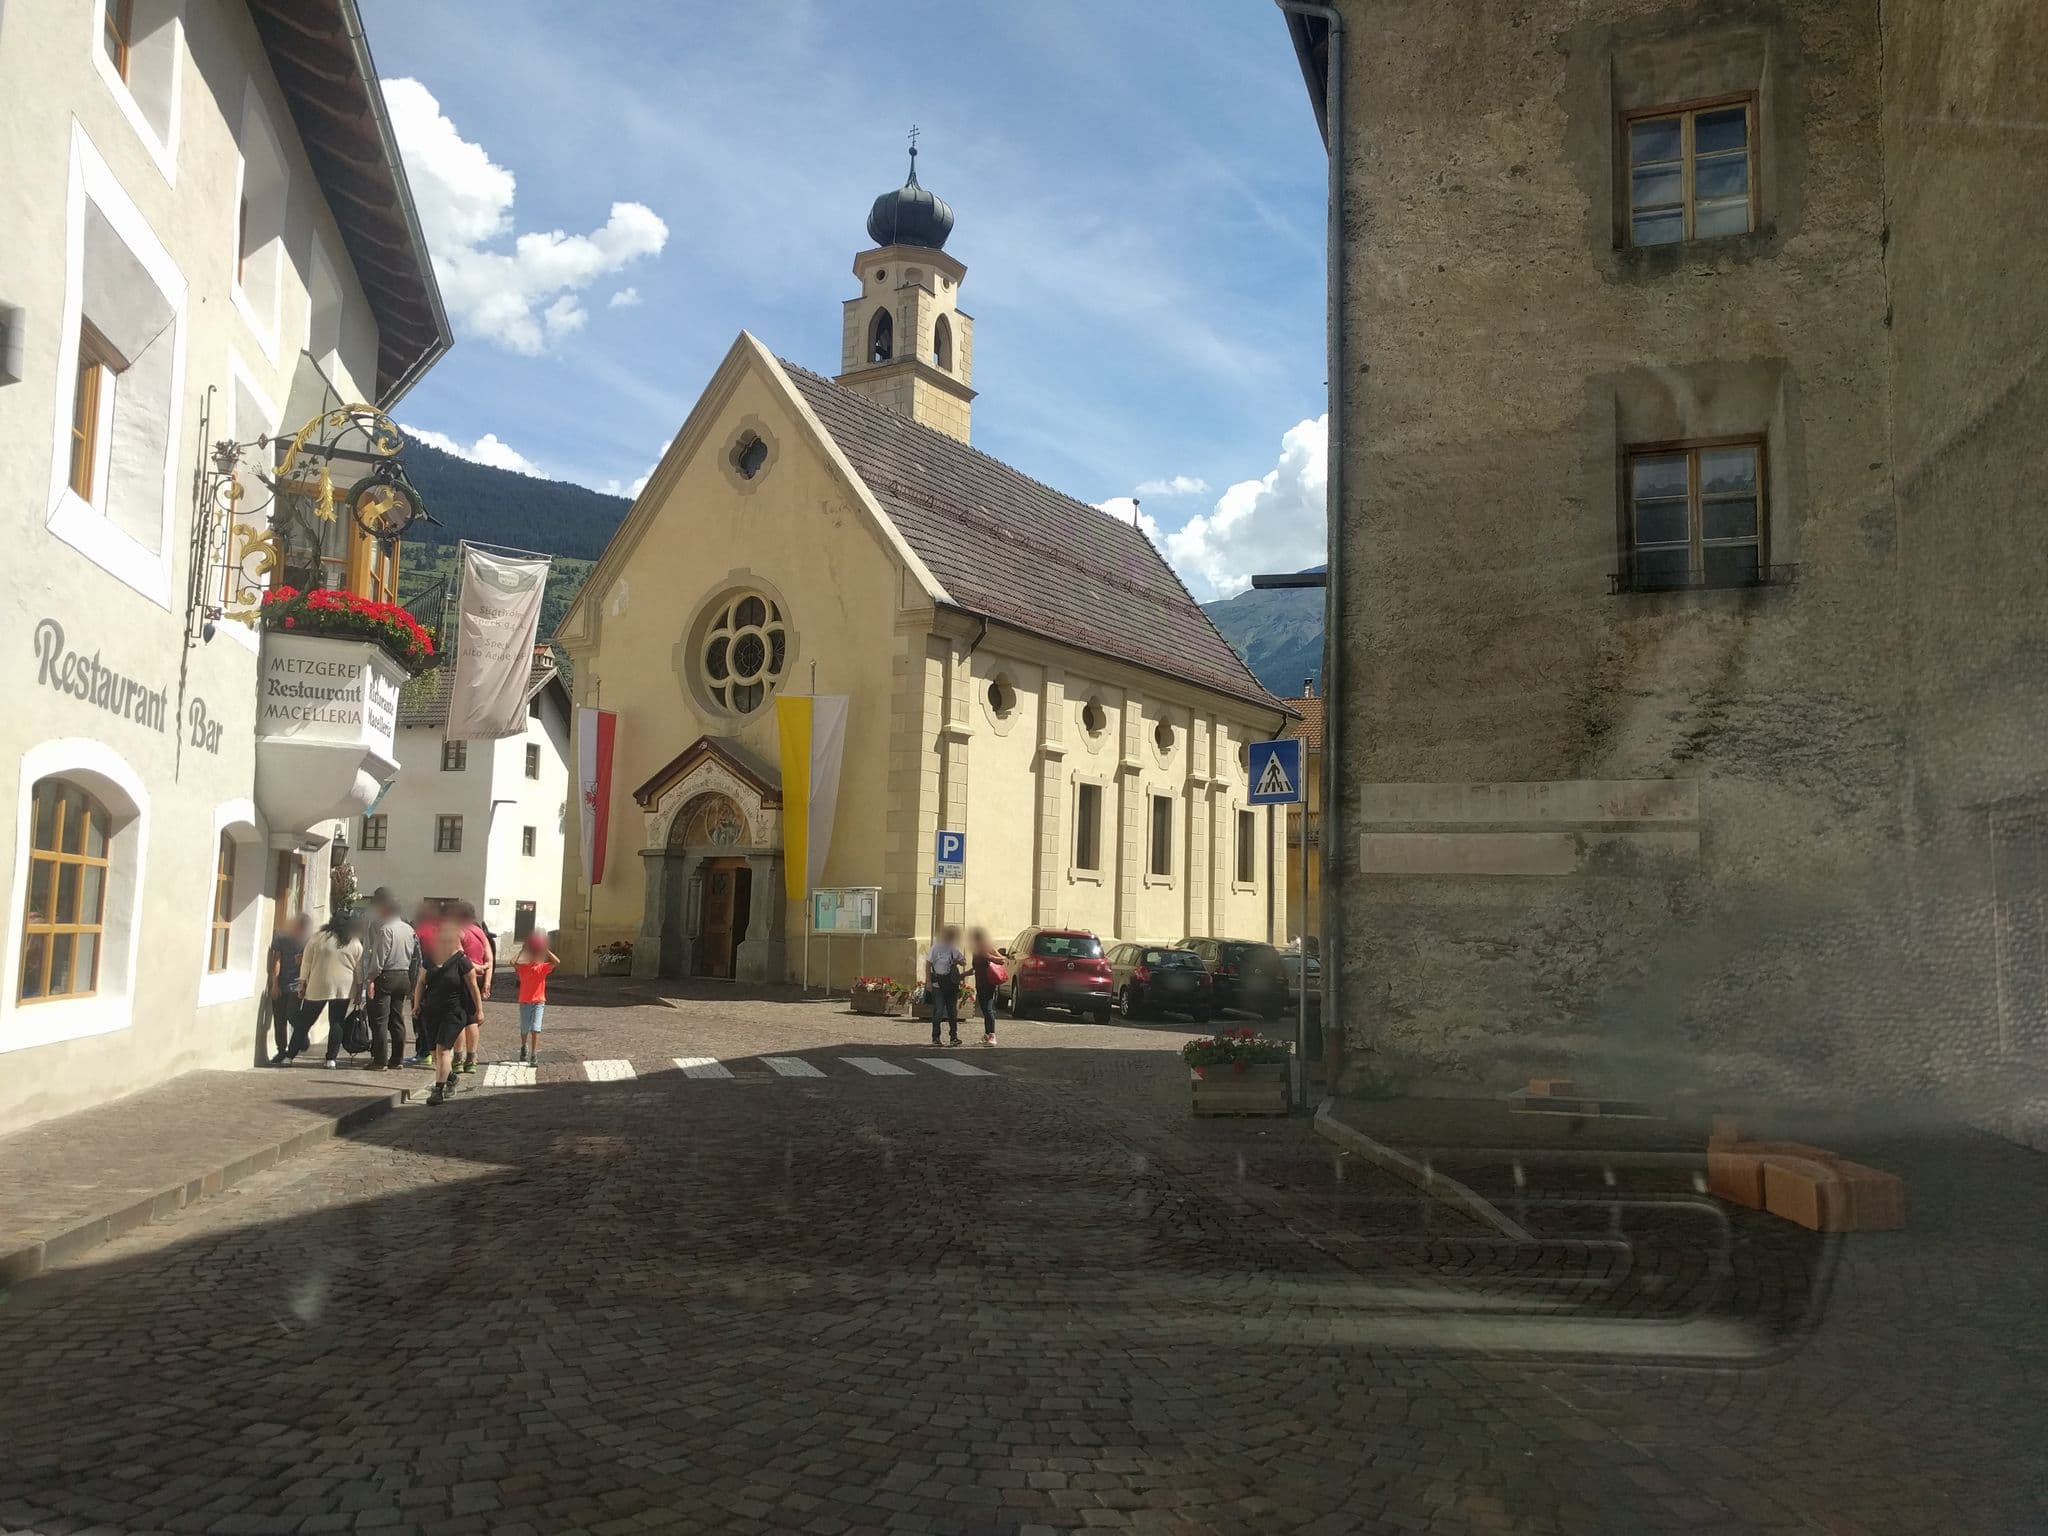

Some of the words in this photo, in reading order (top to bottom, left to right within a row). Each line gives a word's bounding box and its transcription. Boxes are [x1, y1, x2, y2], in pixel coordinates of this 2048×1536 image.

[462, 648, 482, 657] Alto
[33, 618, 168, 733] Restaurant
[270, 657, 361, 679] METZGEREI
[267, 678, 362, 702] Restaurant
[189, 697, 223, 755] Bar
[263, 703, 362, 725] MACELLERIA
[367, 706, 392, 738] Macelleria
[943, 835, 959, 859] P
